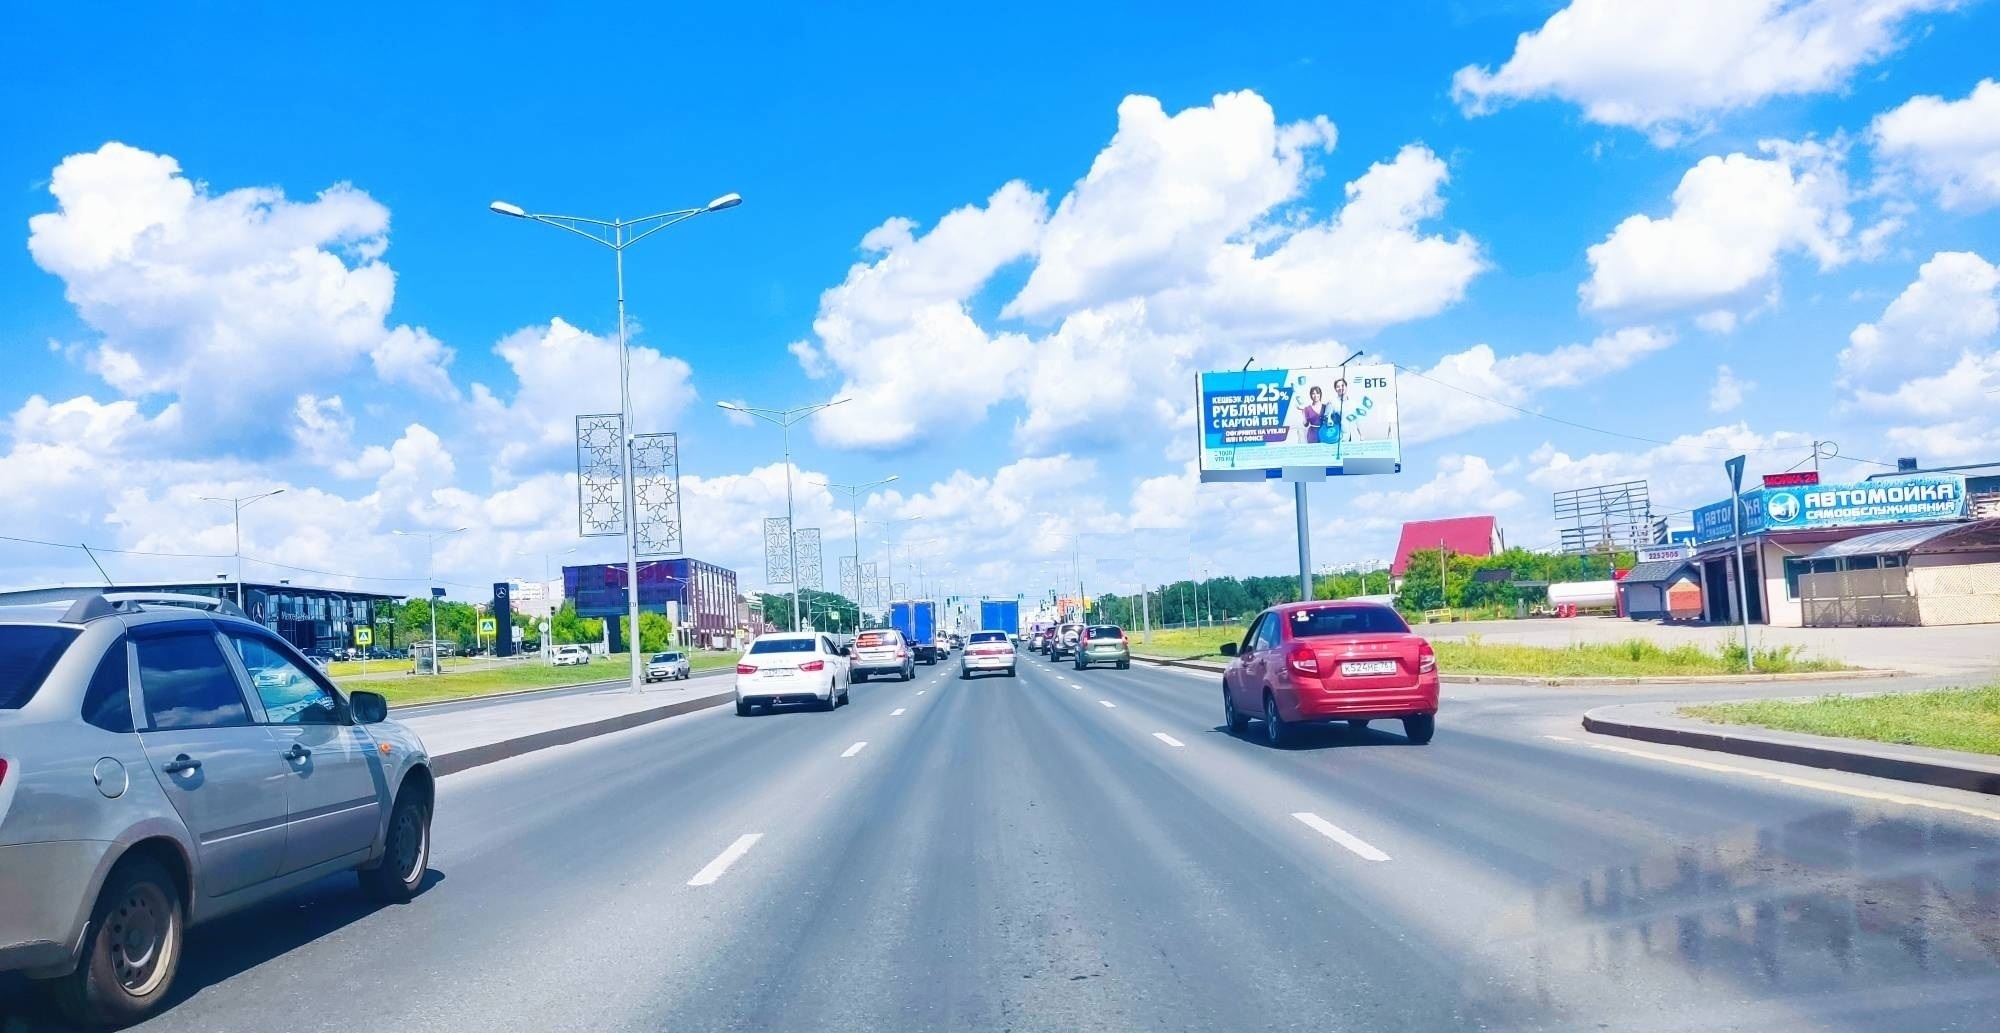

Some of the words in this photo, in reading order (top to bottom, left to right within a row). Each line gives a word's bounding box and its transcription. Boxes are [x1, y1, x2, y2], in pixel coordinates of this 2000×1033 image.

[1364, 377, 1387, 388] ВТБ
[1212, 395, 1243, 404] КЕШБЭК
[1243, 395, 1256, 403] ДО
[1256, 382, 1290, 402] 25%
[1212, 402, 1279, 418] РУБЛЯМИ
[1213, 419, 1220, 429] С
[1221, 415, 1260, 428] КАРТОЙ
[1261, 416, 1280, 426] ВТБ
[1804, 482, 1954, 509] АВТОМОЙКА
[1805, 501, 1955, 520] САМООБСЛУЖИВАНИЯ
